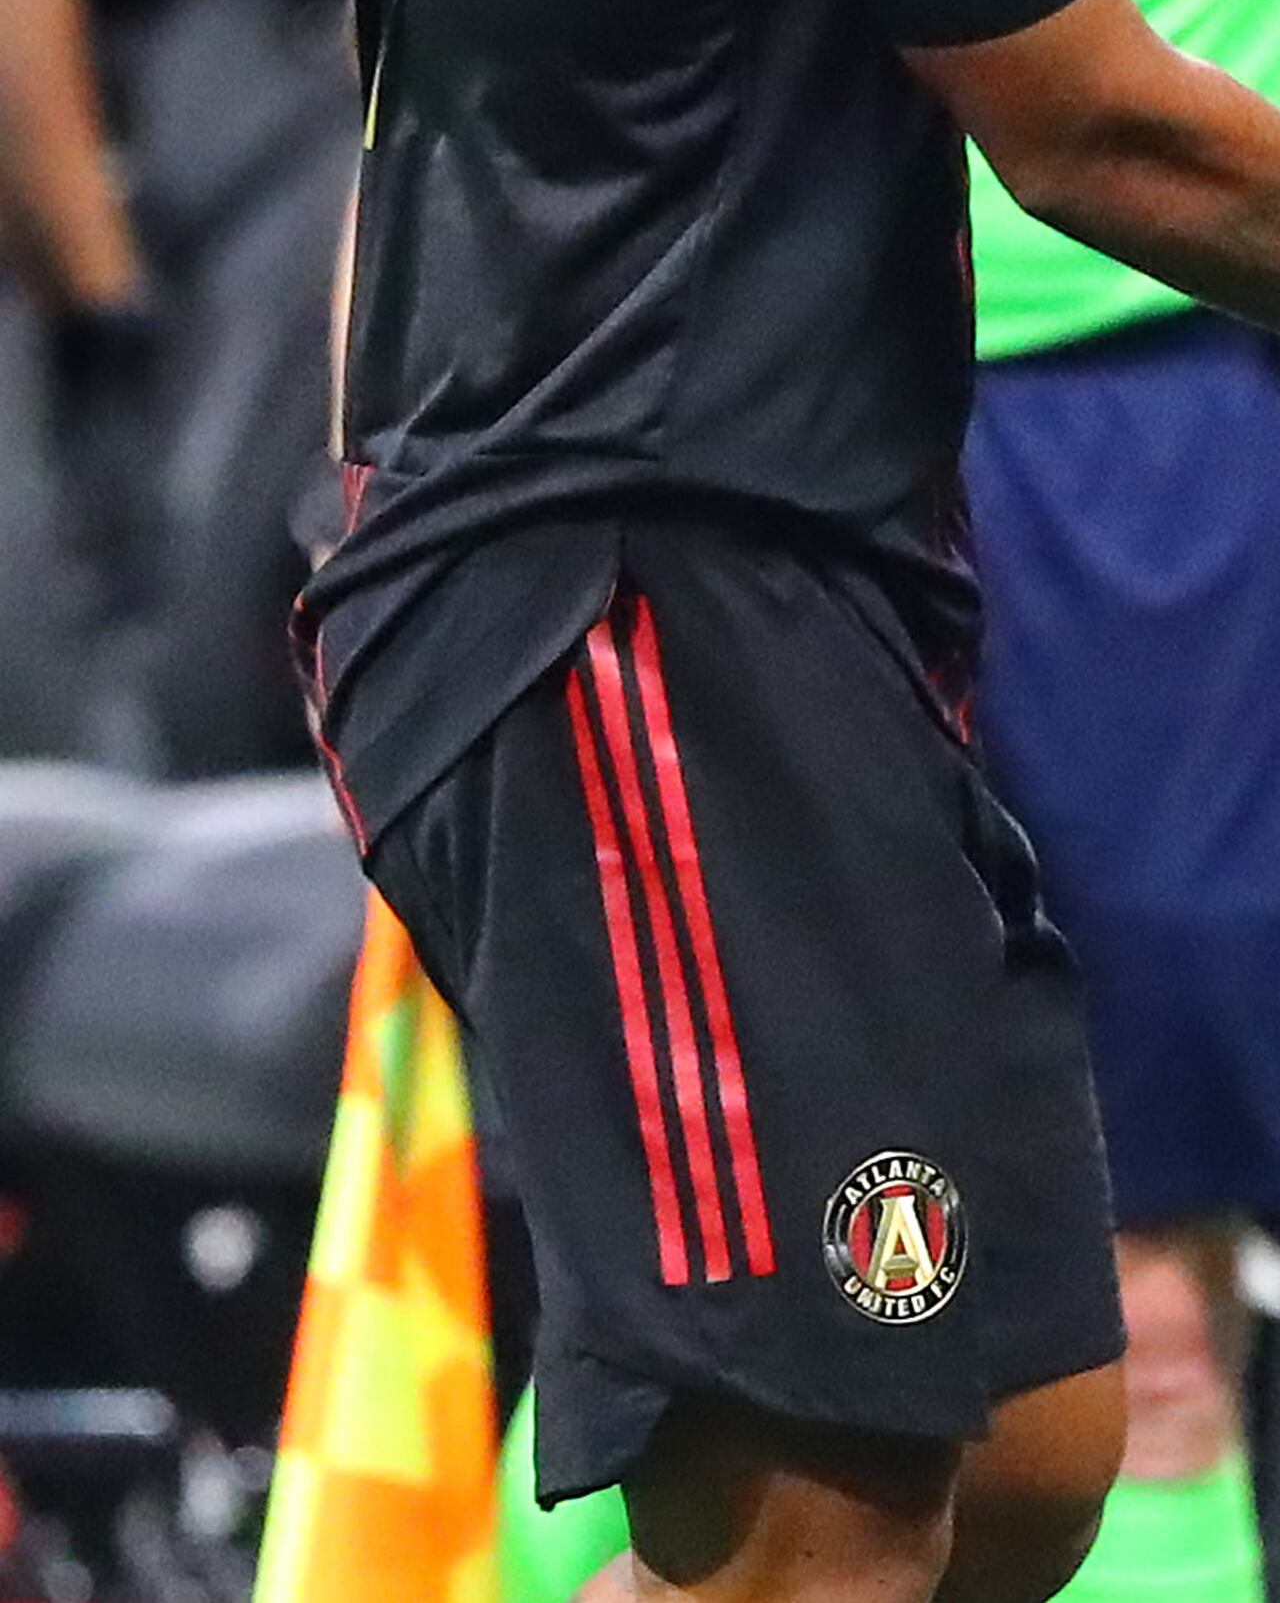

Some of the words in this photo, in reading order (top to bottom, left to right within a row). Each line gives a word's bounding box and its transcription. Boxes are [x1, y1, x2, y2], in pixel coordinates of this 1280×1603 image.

[844, 1159, 947, 1206] ATLANTA
[867, 1195, 935, 1290] A
[843, 1275, 926, 1317] UNITED
[930, 1266, 956, 1298] FC
